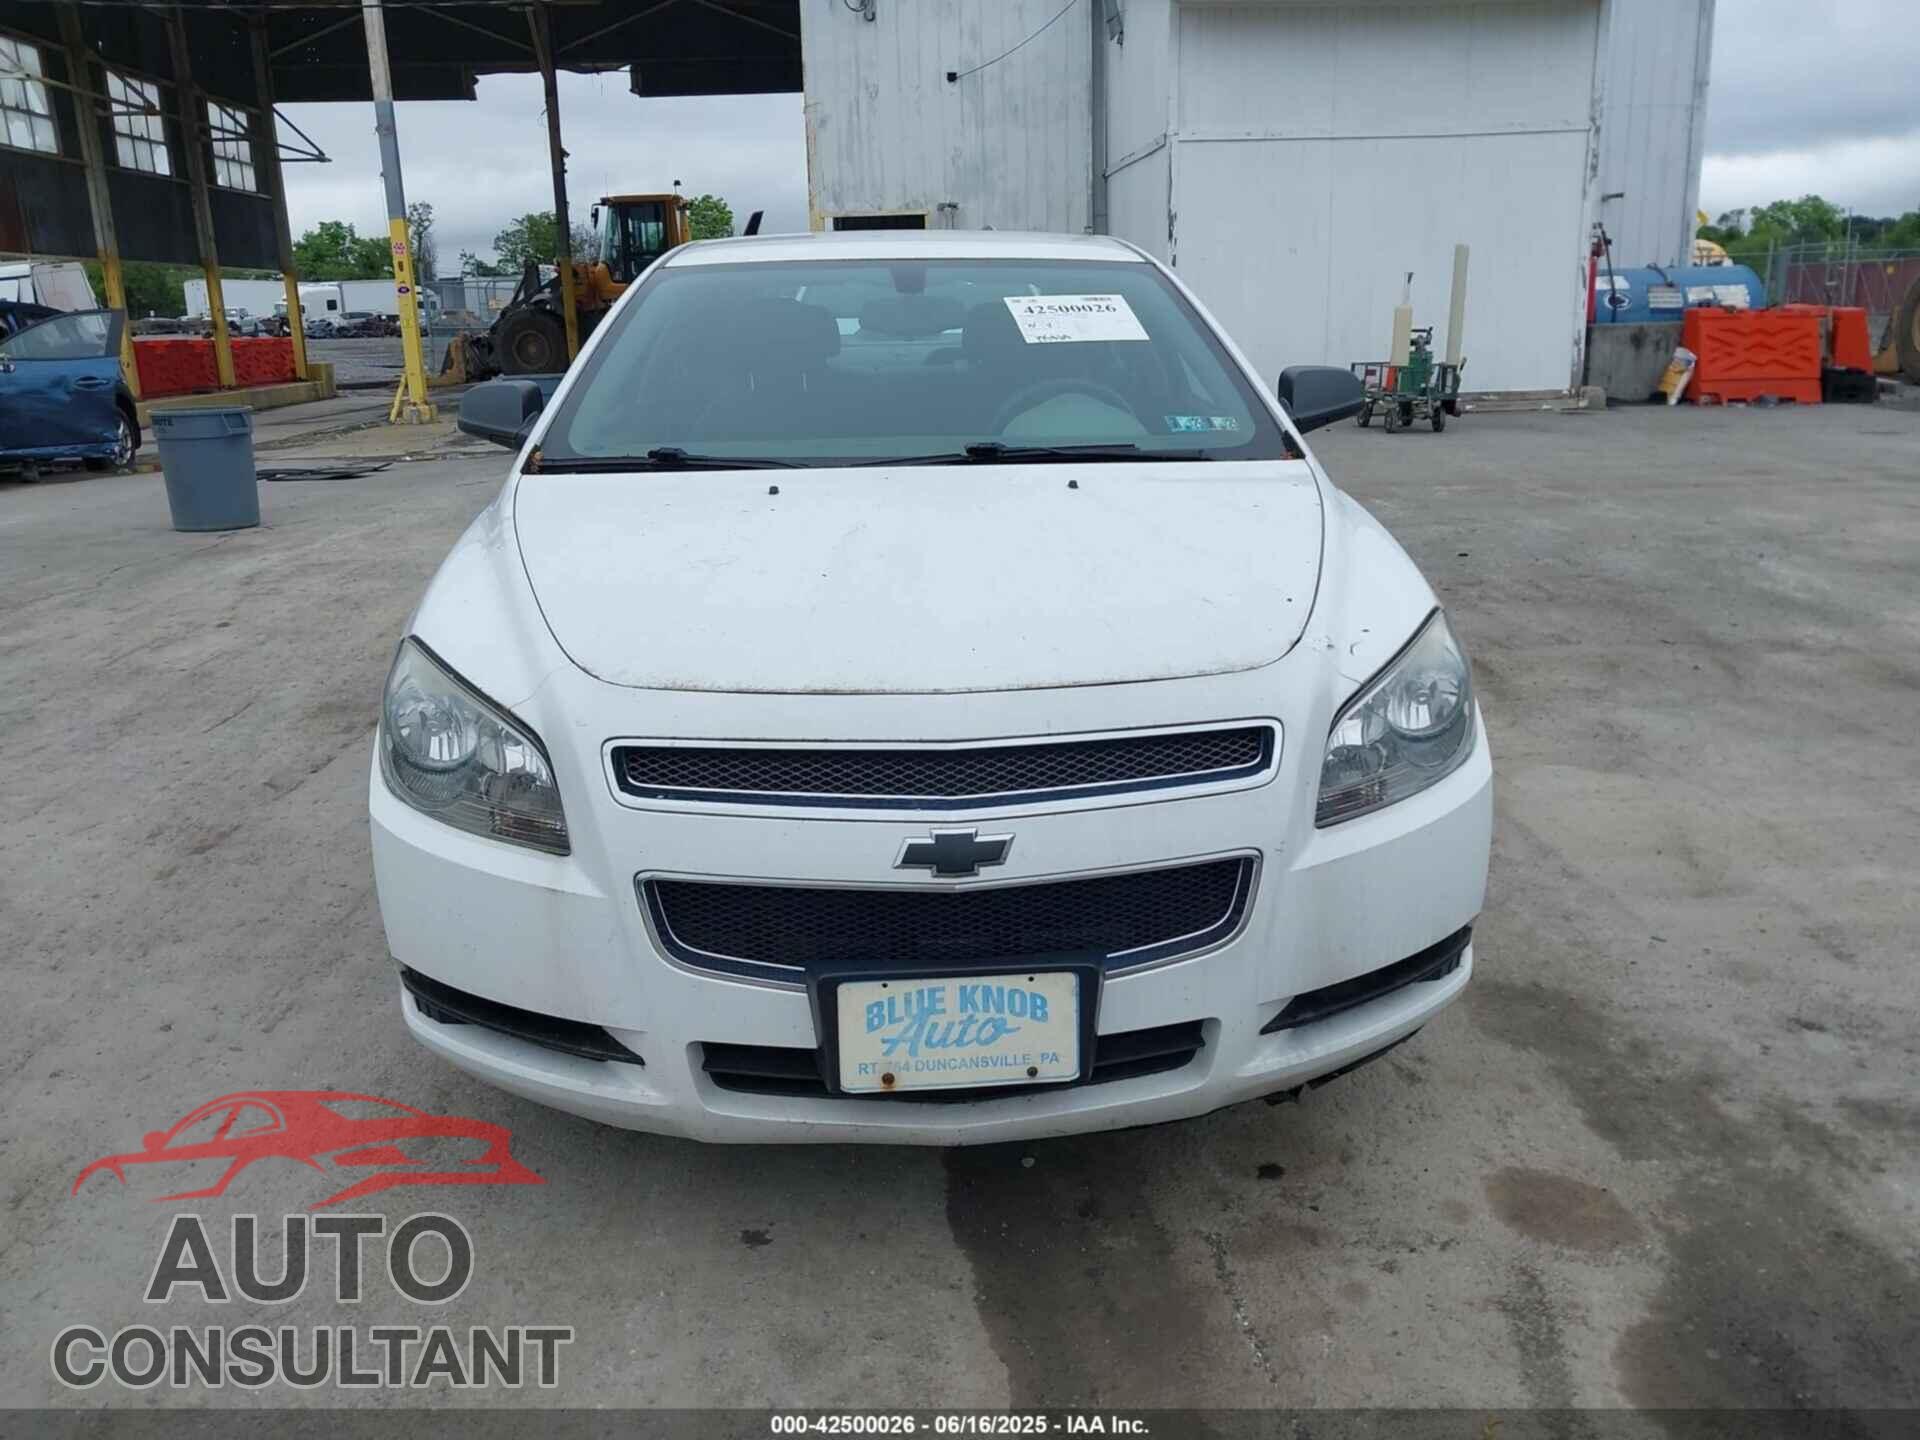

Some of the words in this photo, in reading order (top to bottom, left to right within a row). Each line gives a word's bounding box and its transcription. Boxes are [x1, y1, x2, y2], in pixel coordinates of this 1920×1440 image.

[1024, 303, 1118, 314] 42500026
[865, 987, 946, 1033] BLUE
[959, 984, 1049, 1023] KNOB
[881, 1007, 1021, 1057] Auto
[858, 1062, 879, 1076] RT
[915, 1053, 1031, 1073] DUNCANSVILLE
[1040, 1051, 1060, 1065] PA
